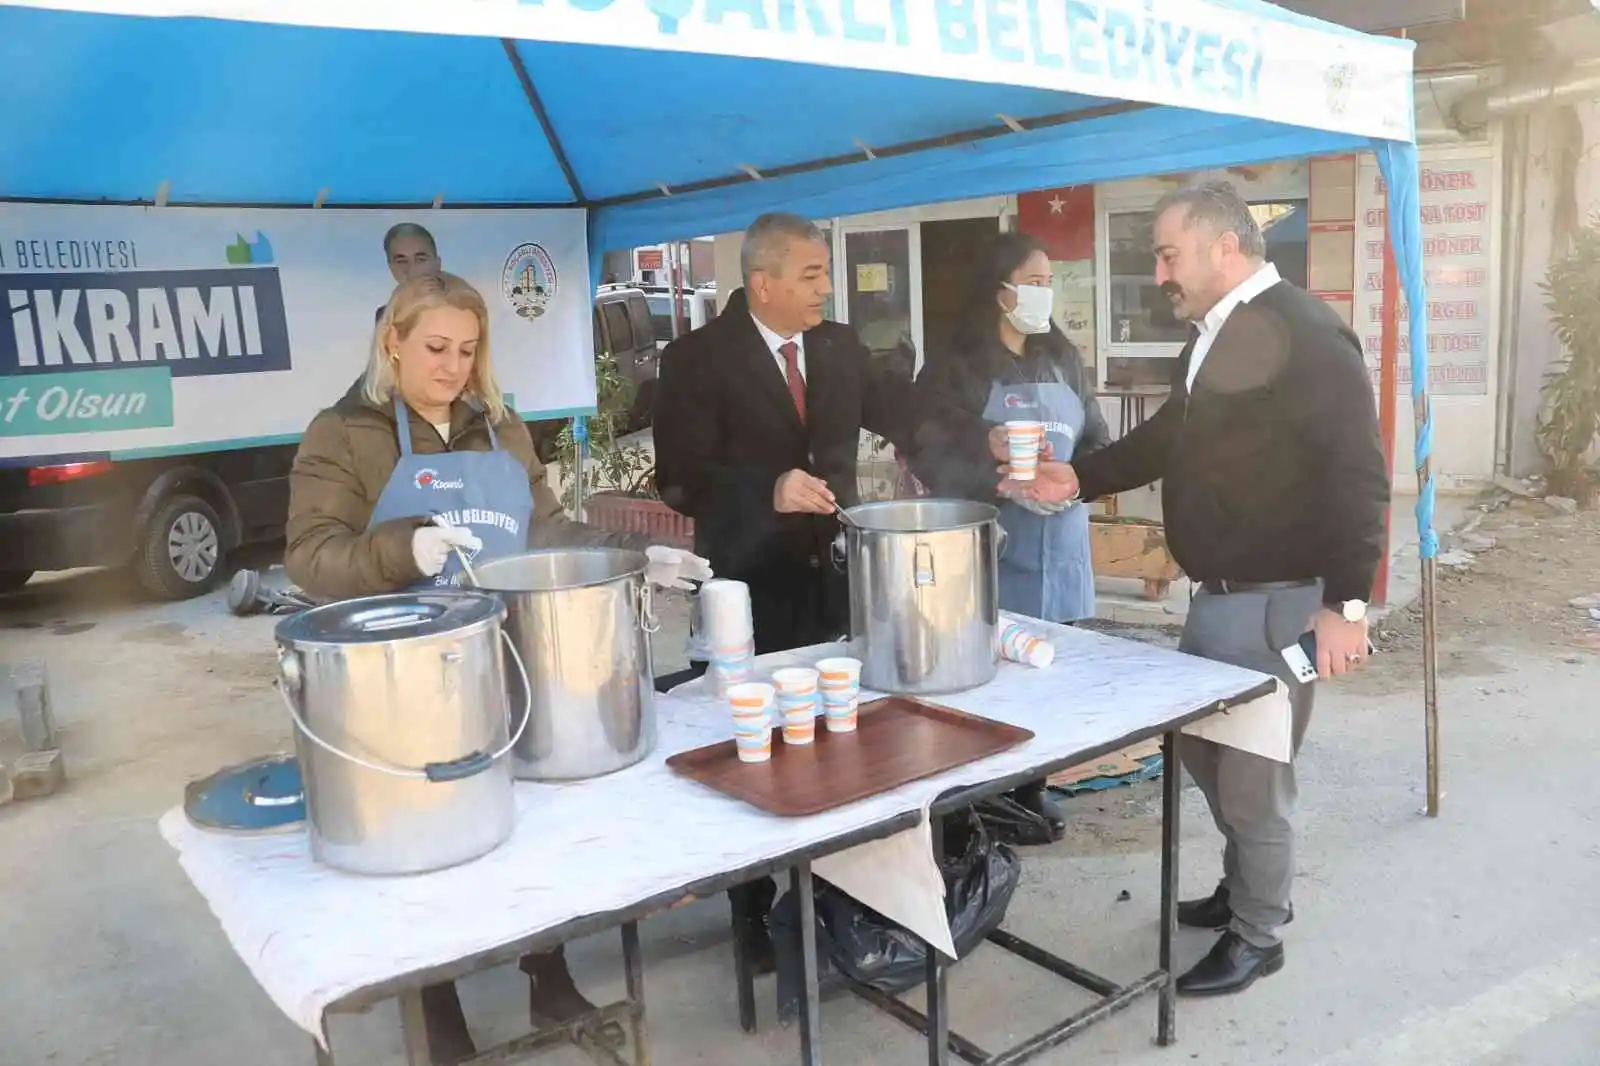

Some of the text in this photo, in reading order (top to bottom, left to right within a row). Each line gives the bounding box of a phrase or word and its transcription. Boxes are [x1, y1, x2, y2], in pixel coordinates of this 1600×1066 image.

[1420, 169, 1476, 192] ÖNER
[16, 239, 138, 268] BELEDİYESİ
[36, 385, 147, 421] Olsun
